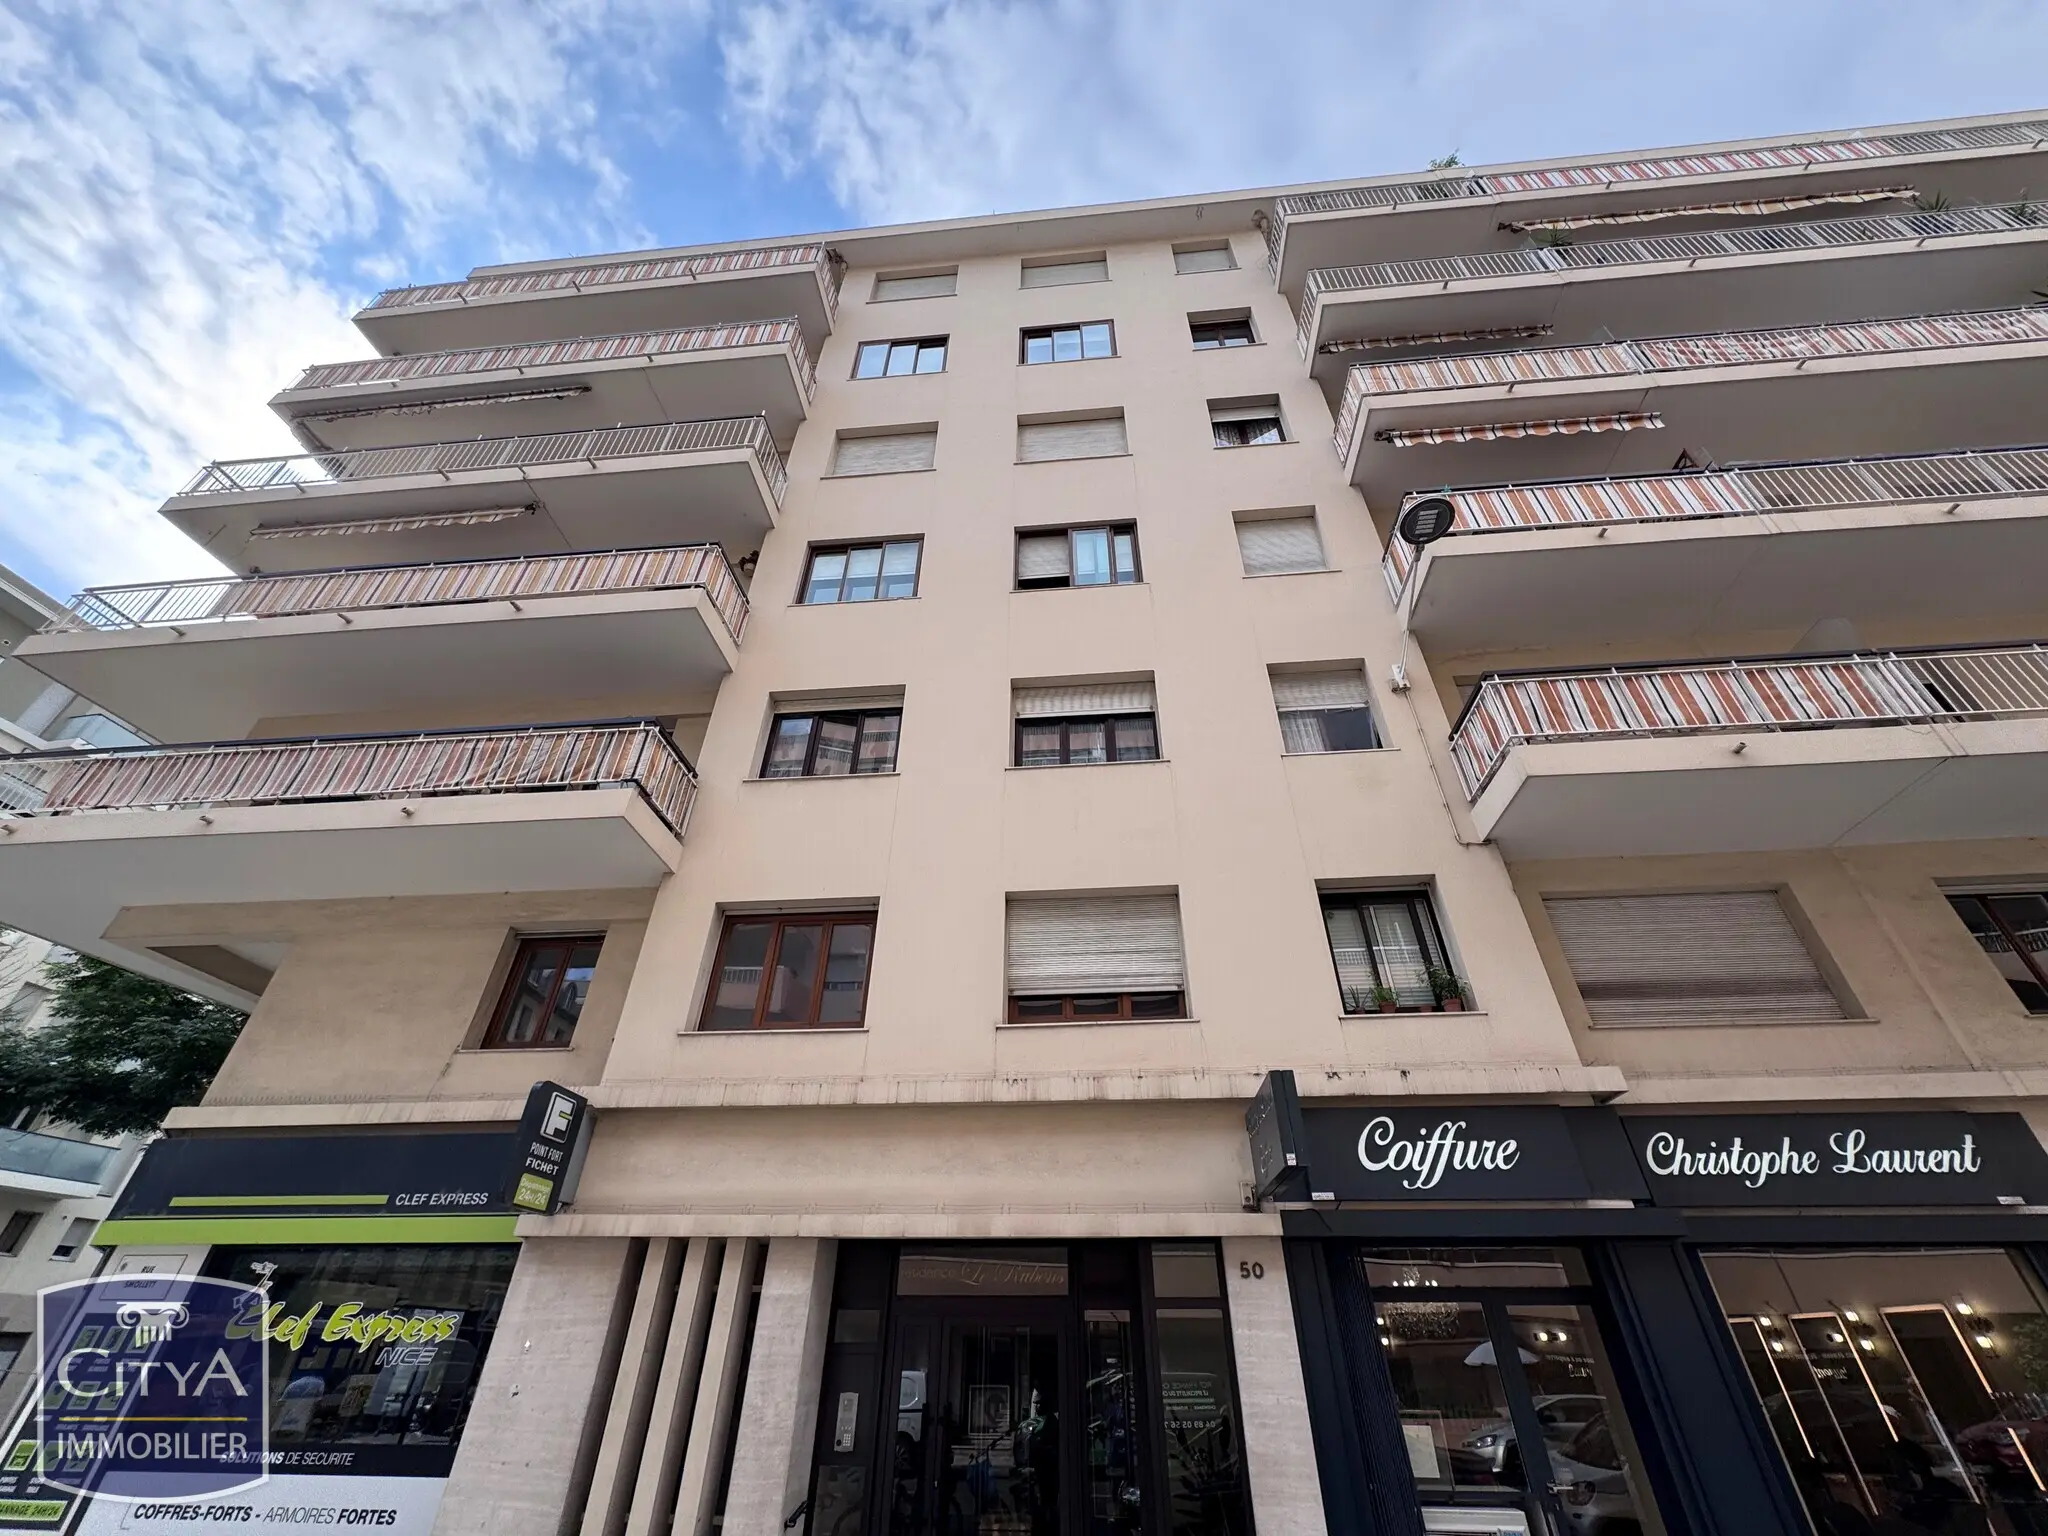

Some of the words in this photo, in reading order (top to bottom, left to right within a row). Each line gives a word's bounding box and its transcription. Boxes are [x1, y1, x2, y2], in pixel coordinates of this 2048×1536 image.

[530, 1142, 549, 1159] POINT
[547, 1149, 564, 1163] FORT
[1358, 1116, 1520, 1189] Coiffure
[1646, 1132, 1820, 1188] Christophe
[1829, 1129, 1981, 1173] Laurent
[395, 1193, 429, 1206] CLEF
[429, 1192, 489, 1206] EXPRESS
[140, 1265, 157, 1274] RUE
[1240, 1261, 1264, 1280] 50
[321, 1301, 460, 1353] Express
[375, 1347, 439, 1368] NICE
[285, 1452, 301, 1465] DE
[302, 1452, 355, 1467] SECURITE
[134, 1503, 253, 1522] COFFRES-FORTS
[263, 1506, 335, 1525] ARMOIRES
[336, 1508, 397, 1526] FORTES
